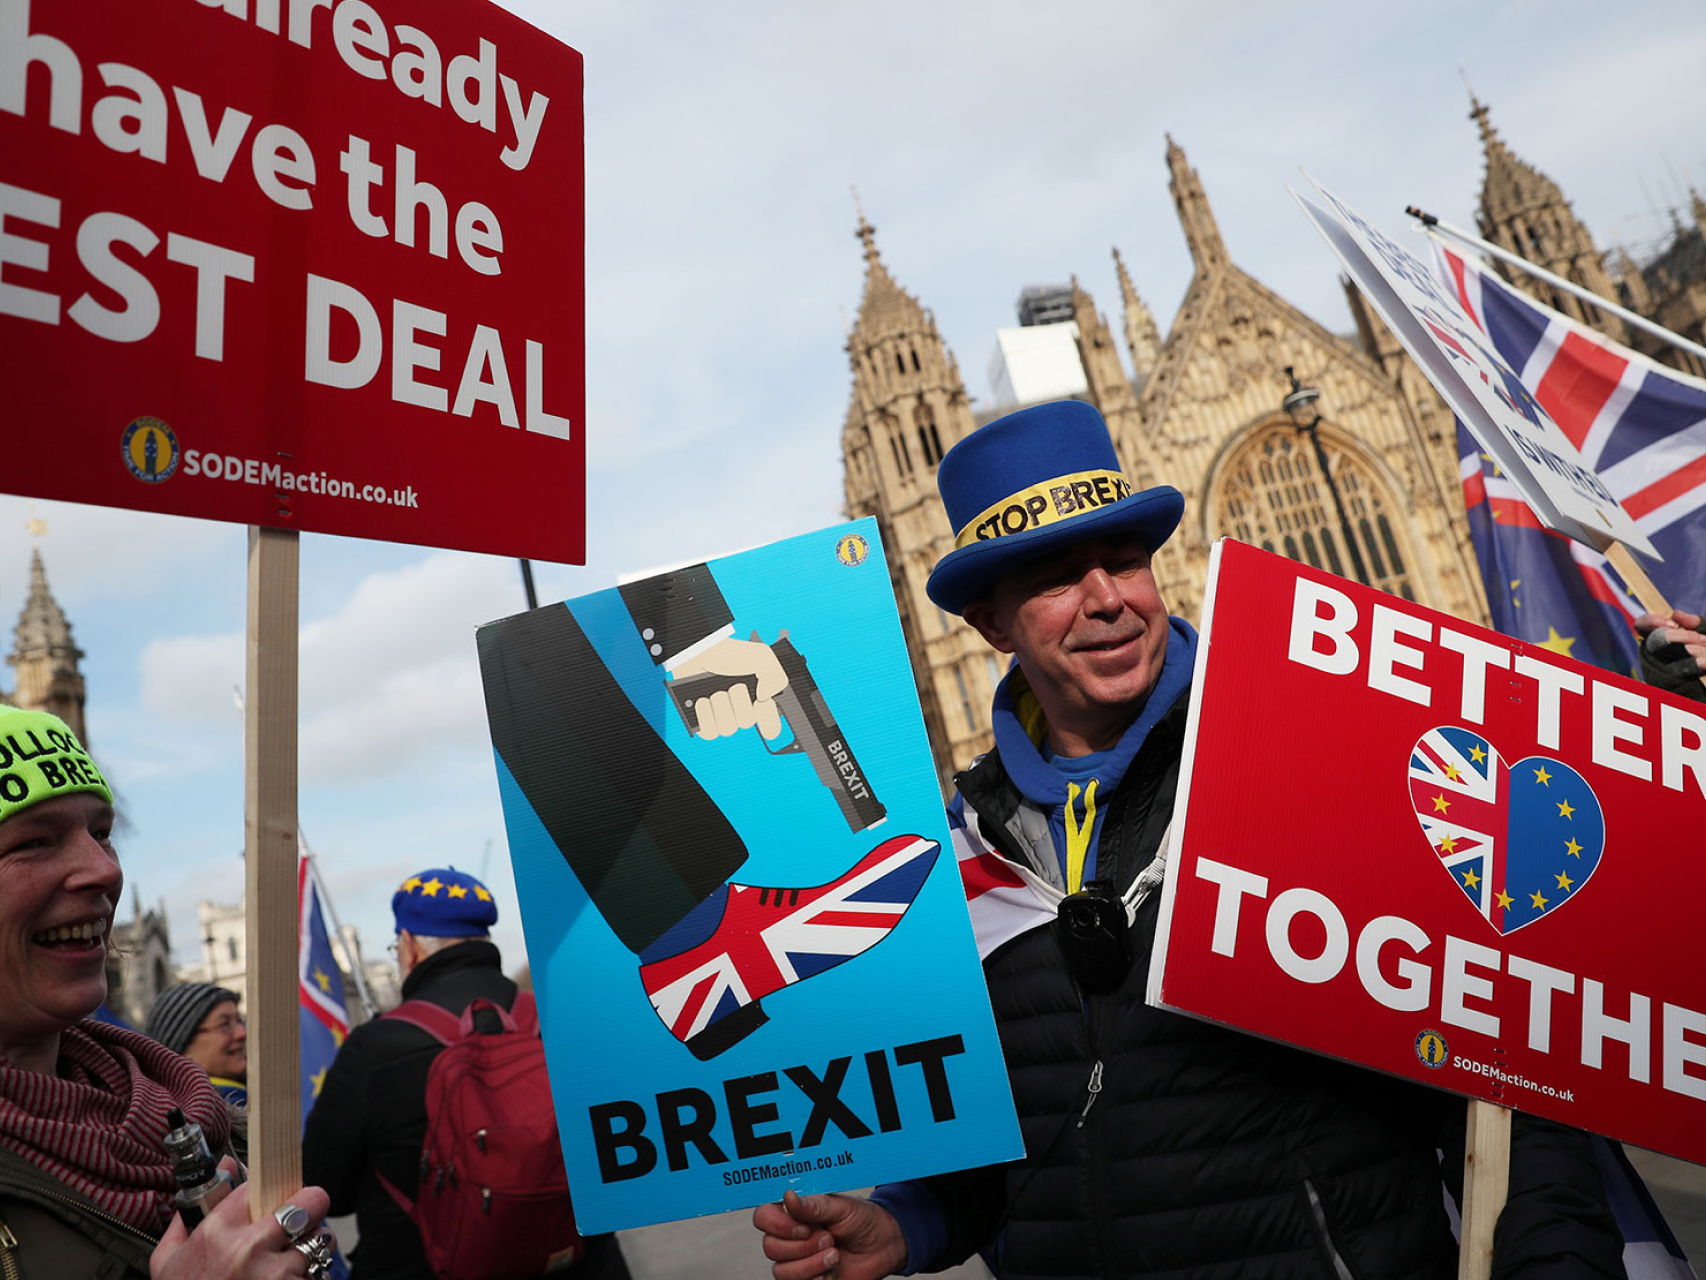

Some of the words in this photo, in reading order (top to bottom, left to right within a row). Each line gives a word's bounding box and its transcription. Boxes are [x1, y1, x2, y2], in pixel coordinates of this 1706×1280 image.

[0, 0, 317, 210] have
[340, 133, 504, 275] the
[195, 0, 550, 171] ready
[305, 272, 570, 441] DEAL
[183, 449, 419, 509] SODEMaction.co.uk
[976, 495, 1047, 541] STOP
[1288, 576, 1706, 801] BETTER
[827, 739, 870, 800] BREXIT
[588, 1034, 966, 1184] BREXIT
[1453, 1056, 1574, 1102] SODEMaction.co.uk
[723, 1150, 855, 1187] SODEMaction.co.uk
